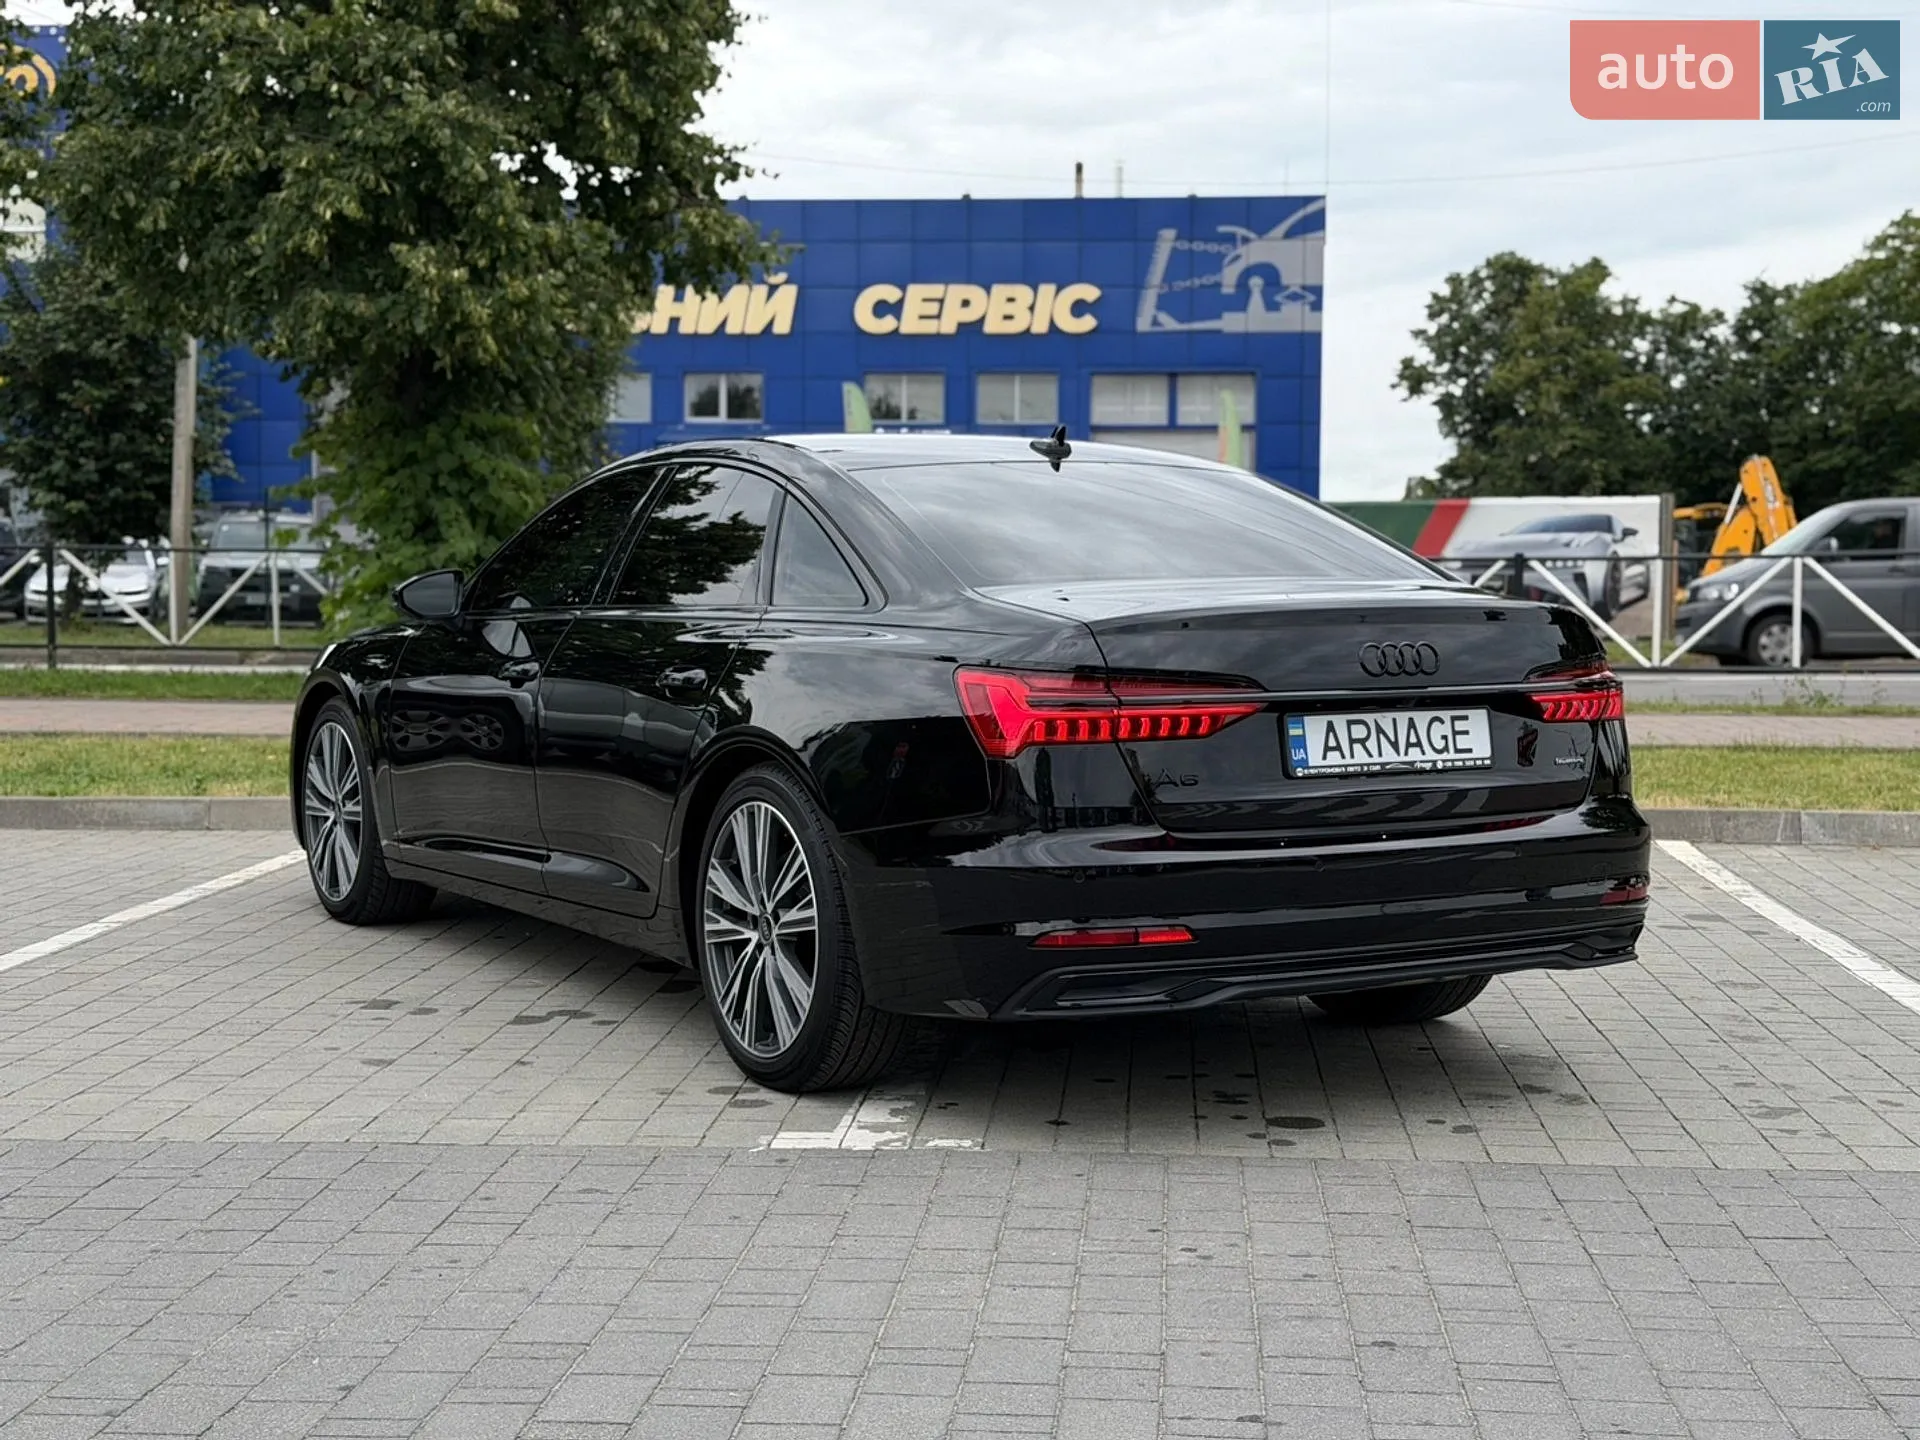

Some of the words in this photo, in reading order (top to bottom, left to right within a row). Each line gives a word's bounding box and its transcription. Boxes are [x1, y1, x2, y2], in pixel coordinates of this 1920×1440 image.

[853, 283, 1102, 335] СЕРВІС
[1291, 748, 1307, 761] UA
[1321, 714, 1474, 761] ARNAGE
[1153, 767, 1200, 788] A6
